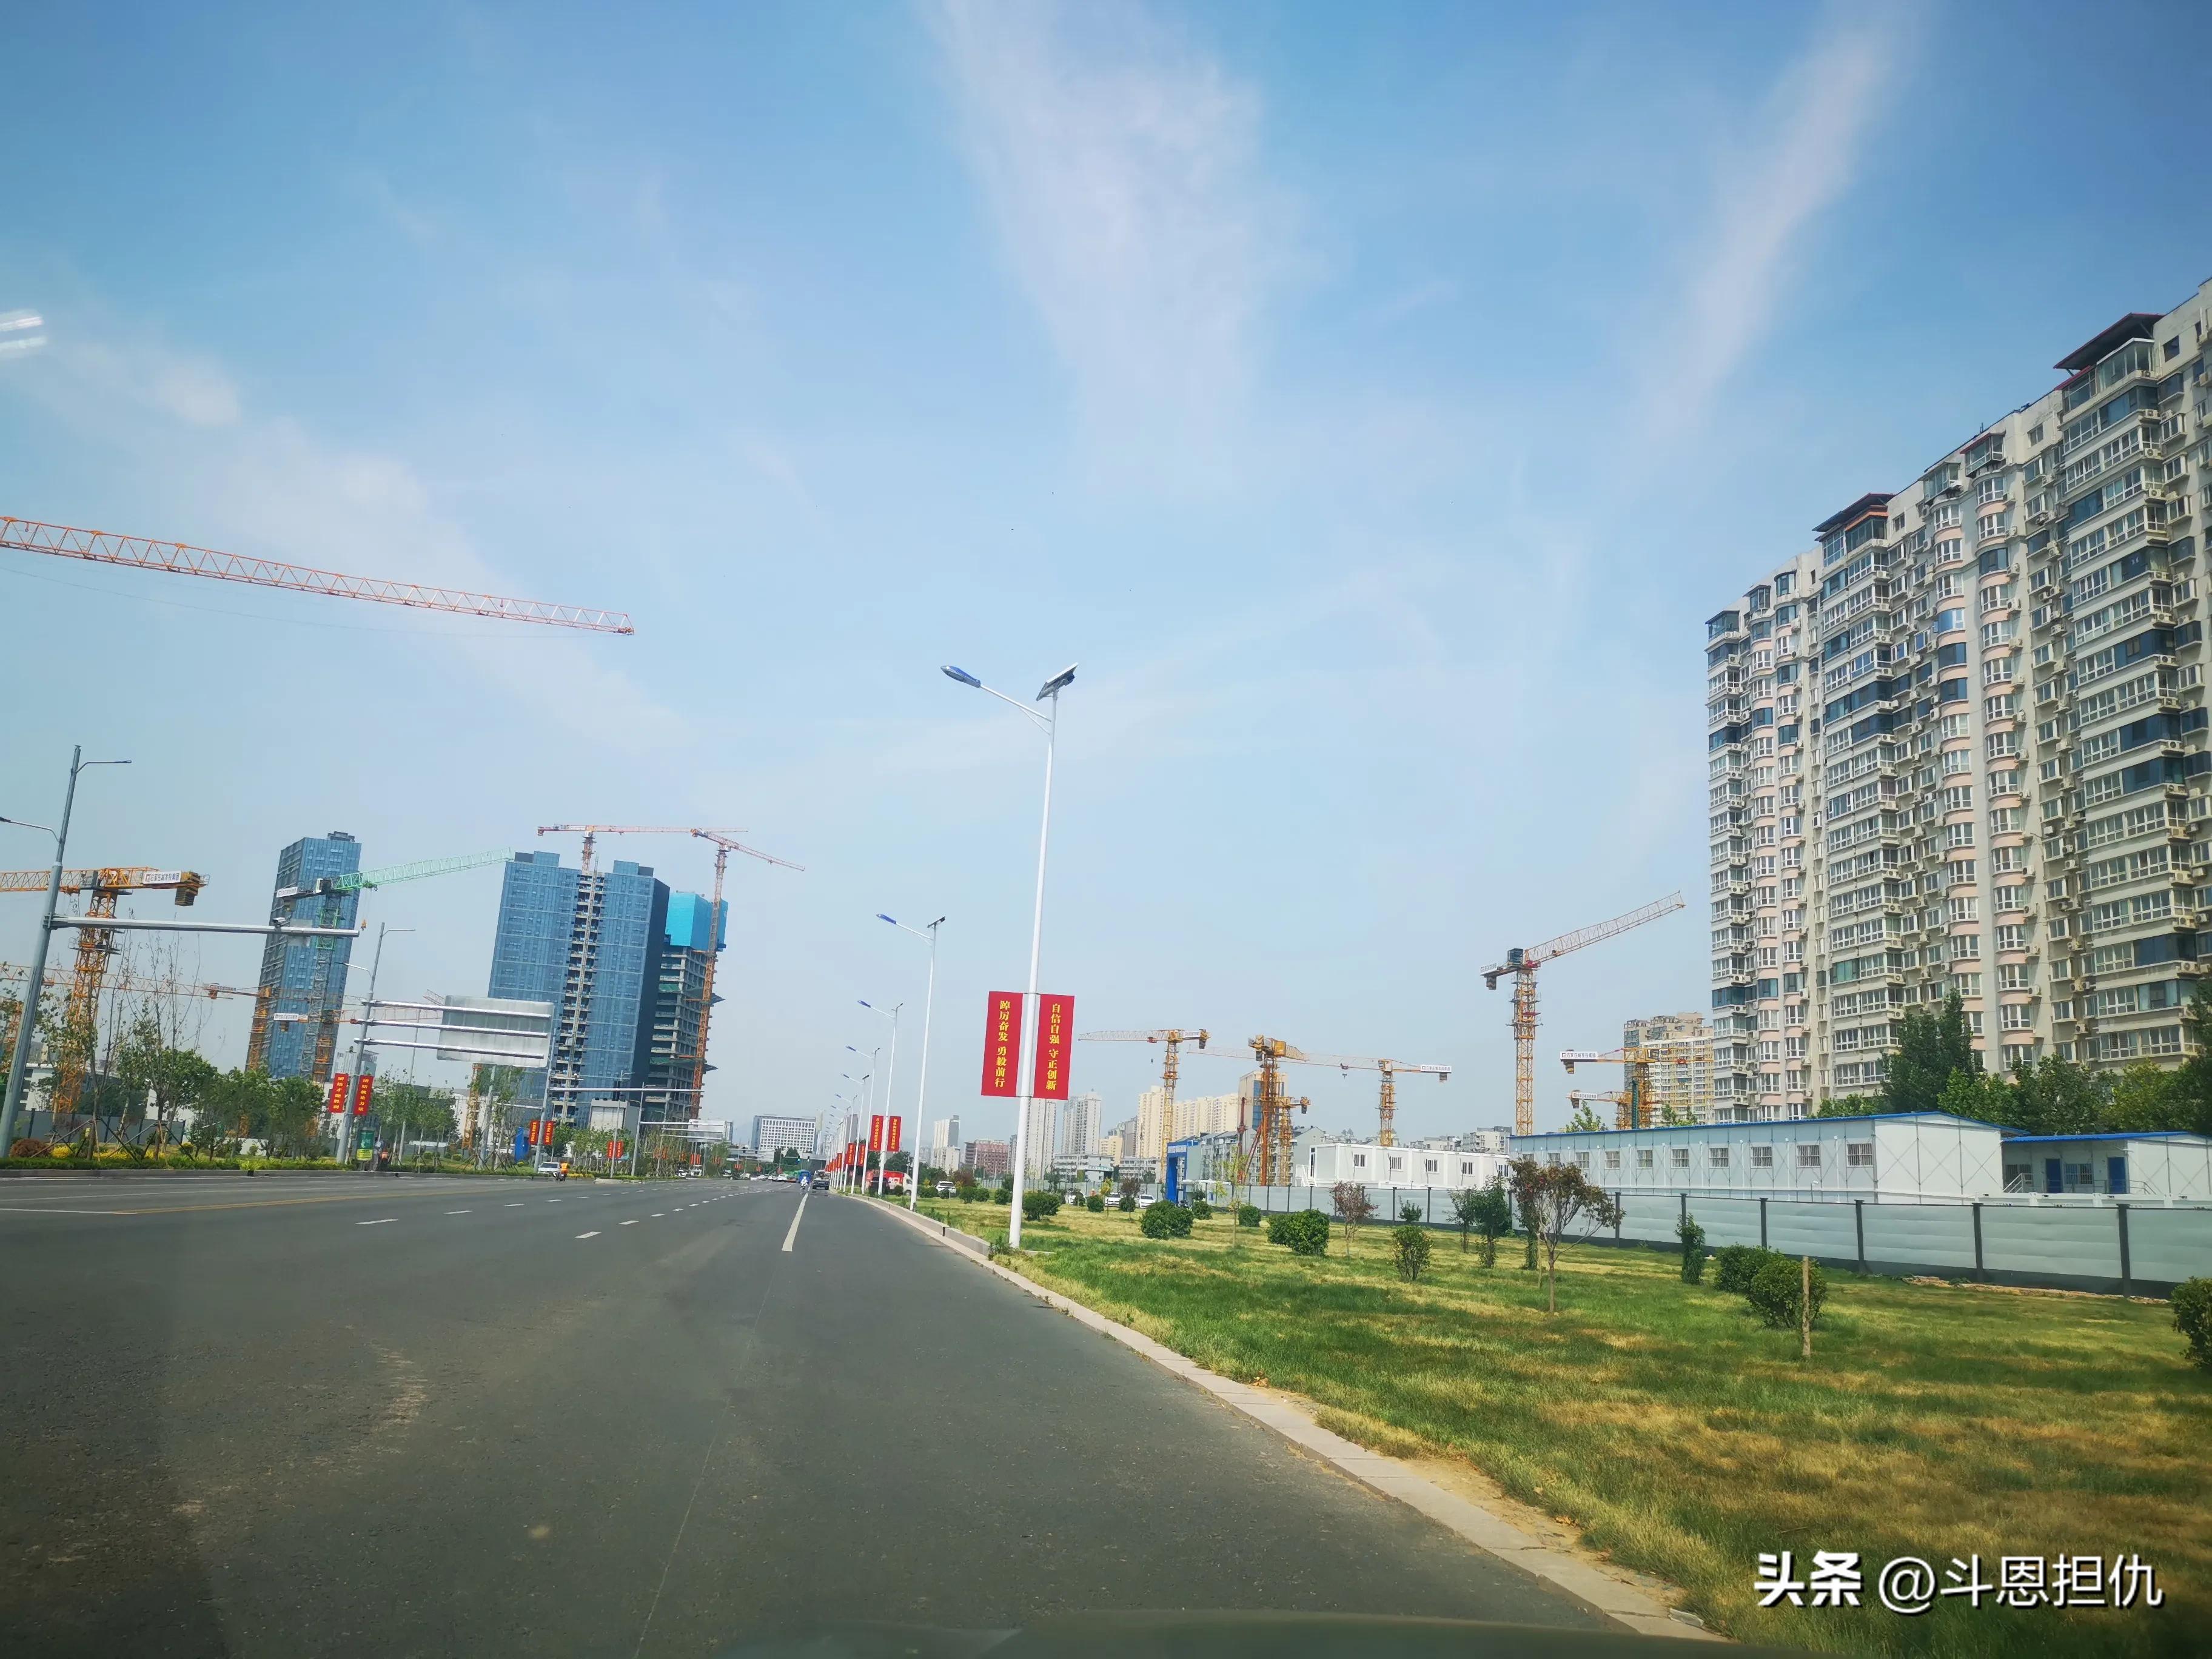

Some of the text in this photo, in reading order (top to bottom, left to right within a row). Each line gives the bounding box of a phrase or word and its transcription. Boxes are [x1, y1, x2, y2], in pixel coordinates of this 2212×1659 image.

[994, 1000, 1011, 1088] 踔厉奋发 勇毅前行
[1045, 1003, 1062, 1090] 自信自强 守正创新
